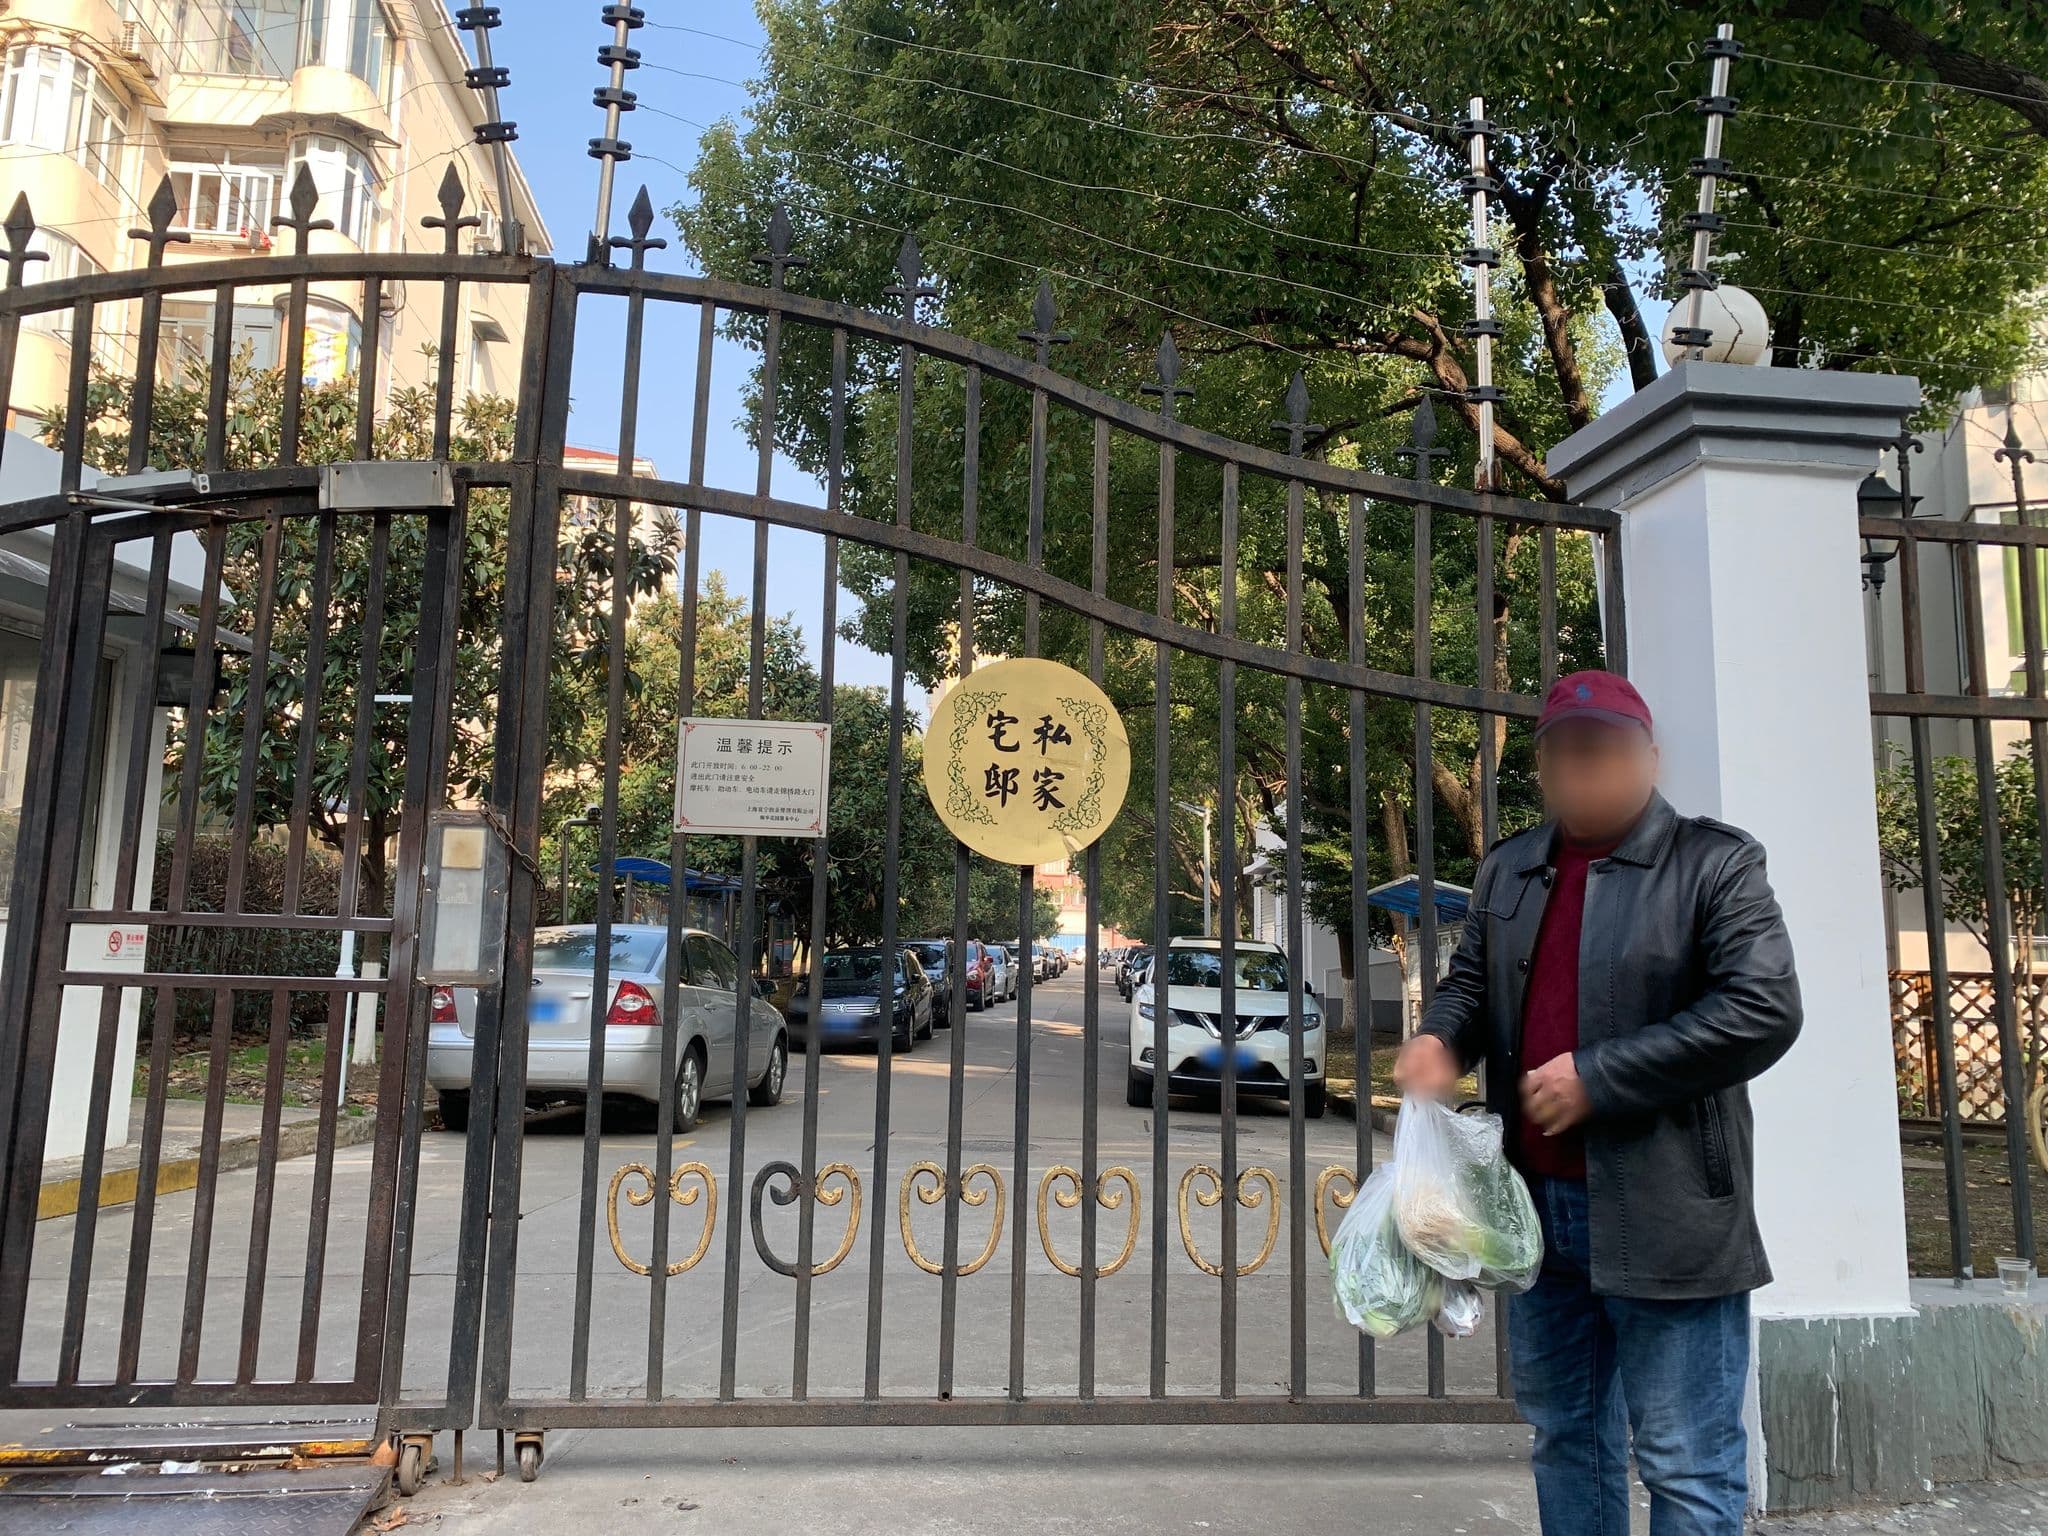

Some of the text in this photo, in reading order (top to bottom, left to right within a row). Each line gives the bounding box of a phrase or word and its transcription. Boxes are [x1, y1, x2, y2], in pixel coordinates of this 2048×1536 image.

[716, 737, 793, 756] 温馨提示
[984, 709, 1020, 808] 宅邸
[1032, 714, 1072, 811] 私家
